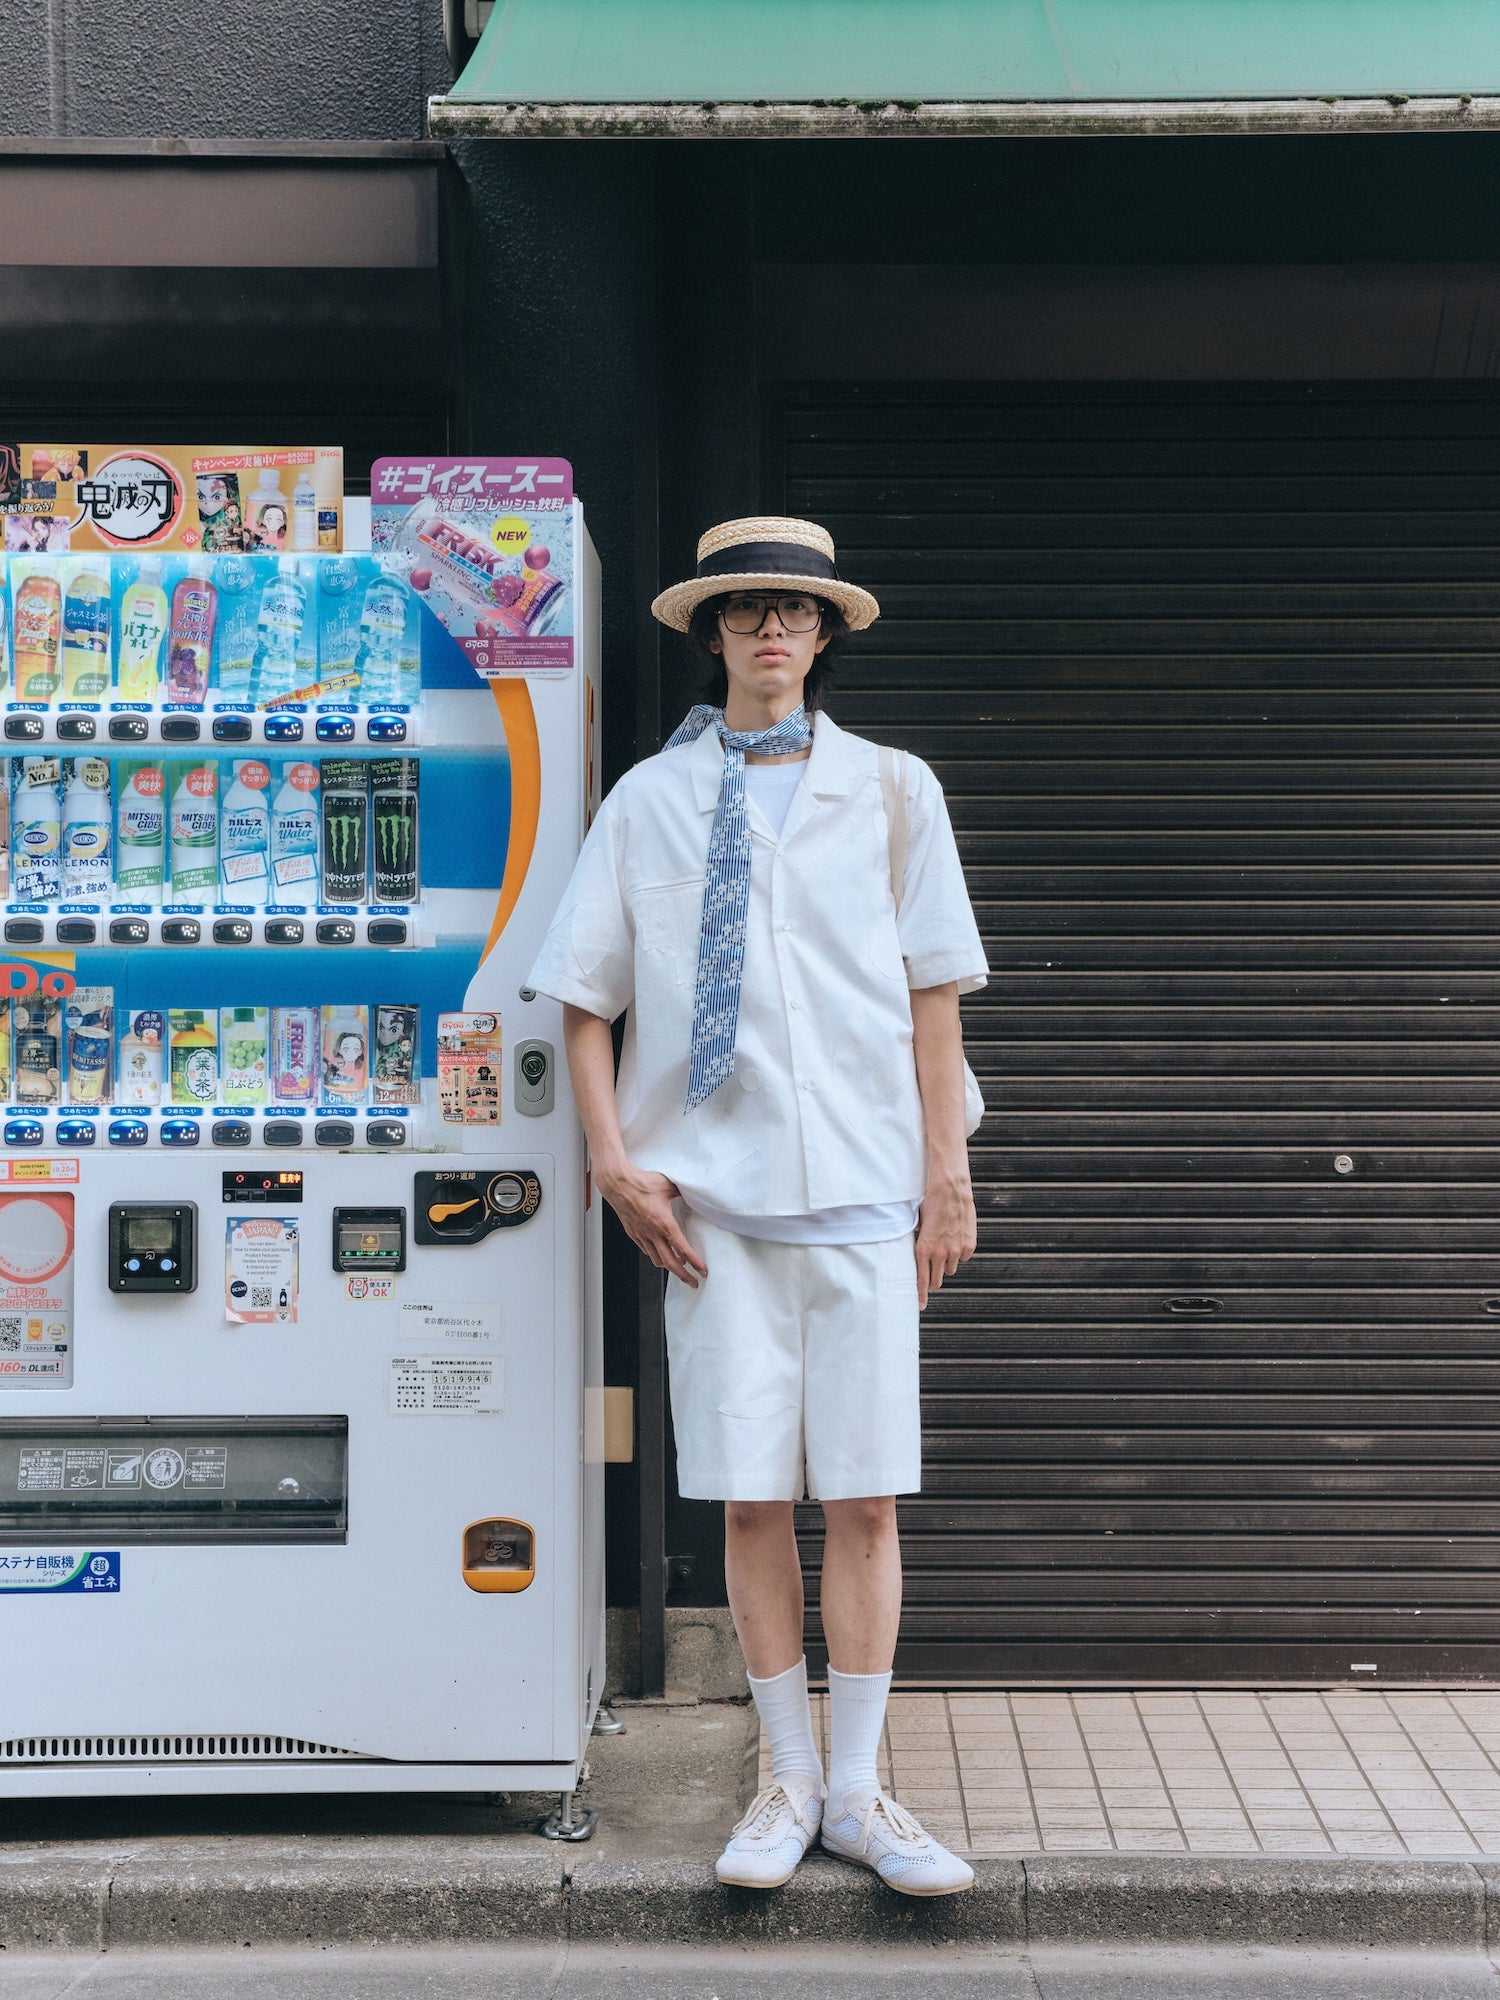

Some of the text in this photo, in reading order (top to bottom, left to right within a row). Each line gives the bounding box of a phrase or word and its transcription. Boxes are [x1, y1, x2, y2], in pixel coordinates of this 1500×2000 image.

[193, 454, 276, 471] キャンペーン実施中!
[378, 464, 565, 494] #ゴイスースー
[68, 480, 174, 530] 鬼滅の刃
[435, 497, 565, 513] 冷感リフレッシュ飲料
[496, 530, 527, 541] NEW
[223, 561, 247, 574] 自然の
[325, 564, 350, 575] 自然の
[430, 551, 473, 582] SPARKLING
[226, 574, 243, 586] 恵み
[330, 575, 346, 587] 恵み
[263, 601, 302, 617] 天然水
[365, 602, 404, 617] 天然水
[66, 608, 107, 624] ジャスミン茶
[123, 622, 161, 639] バナナ
[465, 640, 489, 650] DyDo
[324, 677, 357, 691] コーナー
[28, 763, 59, 784] No.1
[85, 775, 106, 784] No.1
[323, 775, 367, 785] モンスターエナジー
[373, 775, 417, 785] モンスターエナジー
[138, 782, 161, 792] 爽快
[190, 782, 214, 792] 爽快
[229, 819, 263, 827] カルピス
[279, 820, 313, 829] カルピス
[227, 826, 263, 838] Water
[277, 828, 313, 839] Water
[15, 859, 59, 868] LEMON
[65, 859, 110, 868] LEMON
[442, 1022, 464, 1030] DyDo
[290, 1021, 304, 1069] FRISK
[72, 1053, 107, 1066] DEMITASSE
[195, 1056, 211, 1092] 葉の茶
[226, 1079, 264, 1089] 白ぶどう
[279, 1173, 301, 1184] 販売中
[434, 1172, 476, 1181] おつり・返却
[246, 1220, 271, 1229] Welcome
[248, 1226, 279, 1237] JAPAN!
[7, 1287, 48, 1299] 無料アプリ
[231, 1285, 247, 1293] SCAN!
[373, 1288, 387, 1297] OK
[0, 1555, 75, 1569] ステナ自販機
[93, 1559, 107, 1573] 超
[82, 1576, 118, 1589] 省エネ
